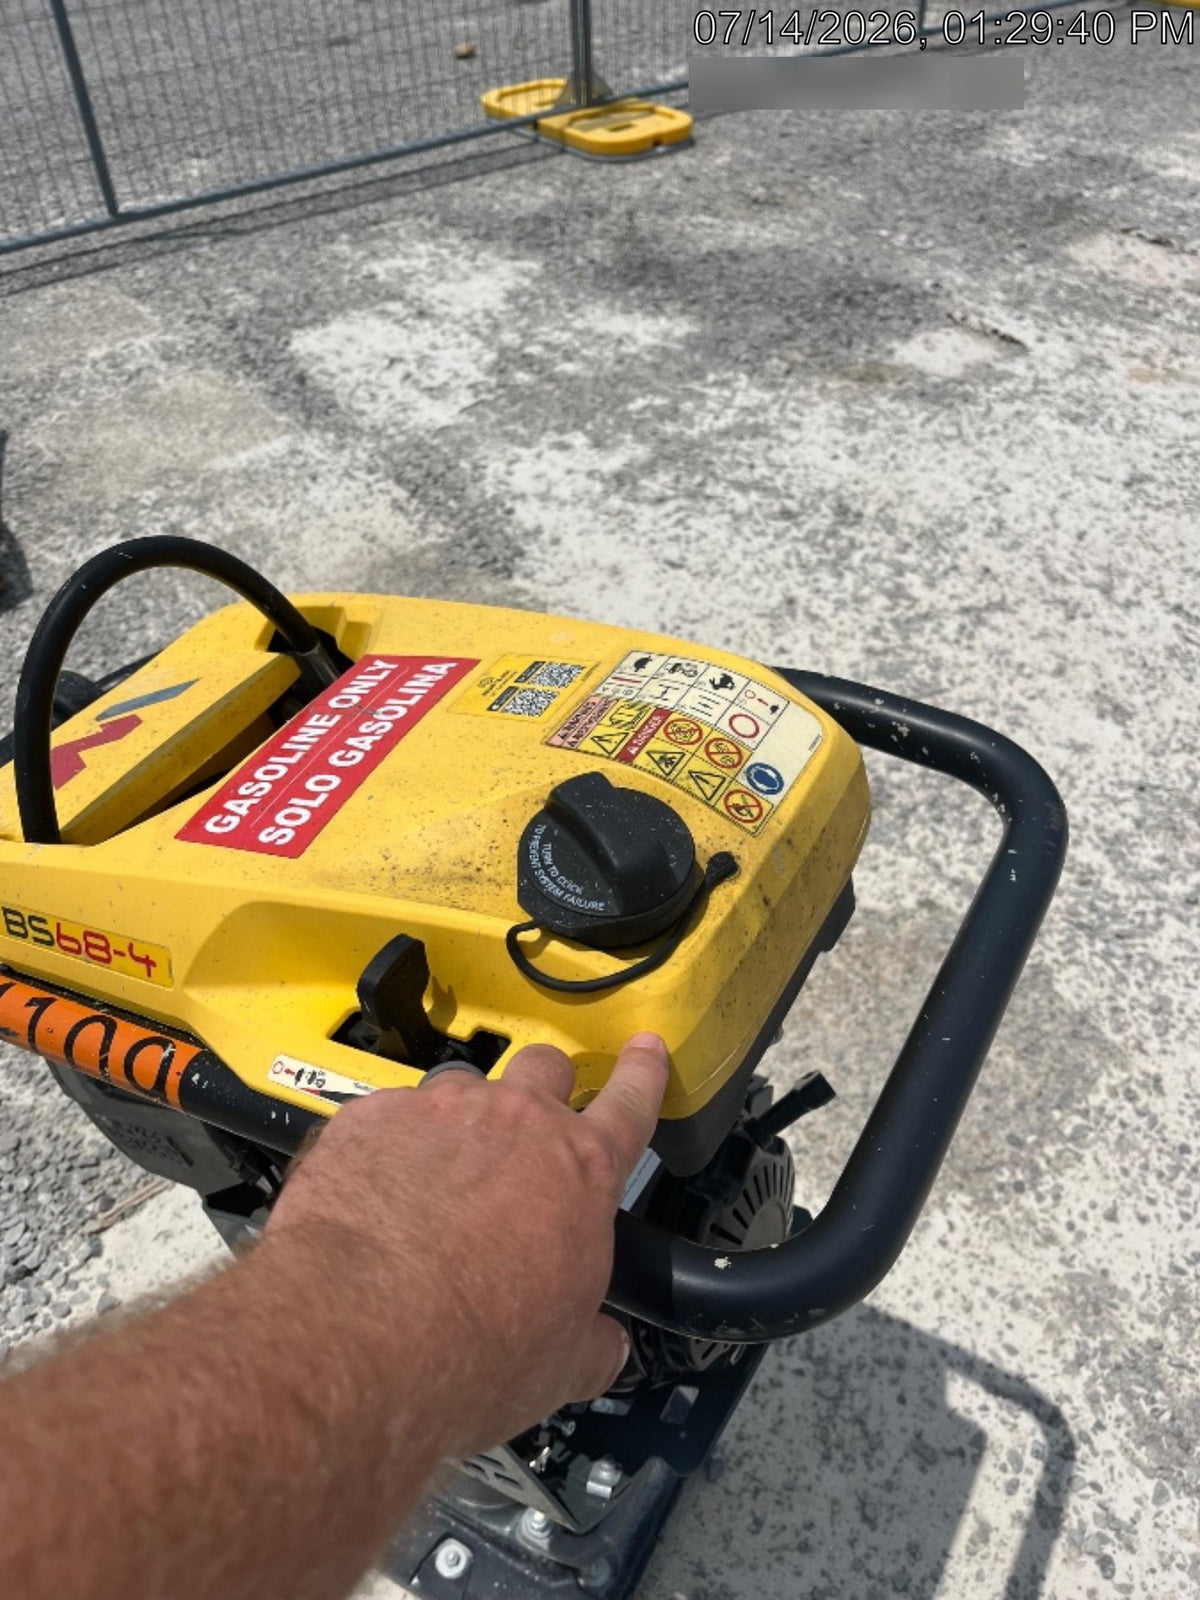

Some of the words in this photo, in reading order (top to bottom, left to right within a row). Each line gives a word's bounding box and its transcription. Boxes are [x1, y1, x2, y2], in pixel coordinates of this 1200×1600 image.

[204, 714, 344, 834] GASOLINE
[328, 659, 399, 710] ONLY
[258, 774, 342, 846] SOLO
[328, 662, 458, 768] GASOLINA
[2, 906, 157, 978] BS68-4
